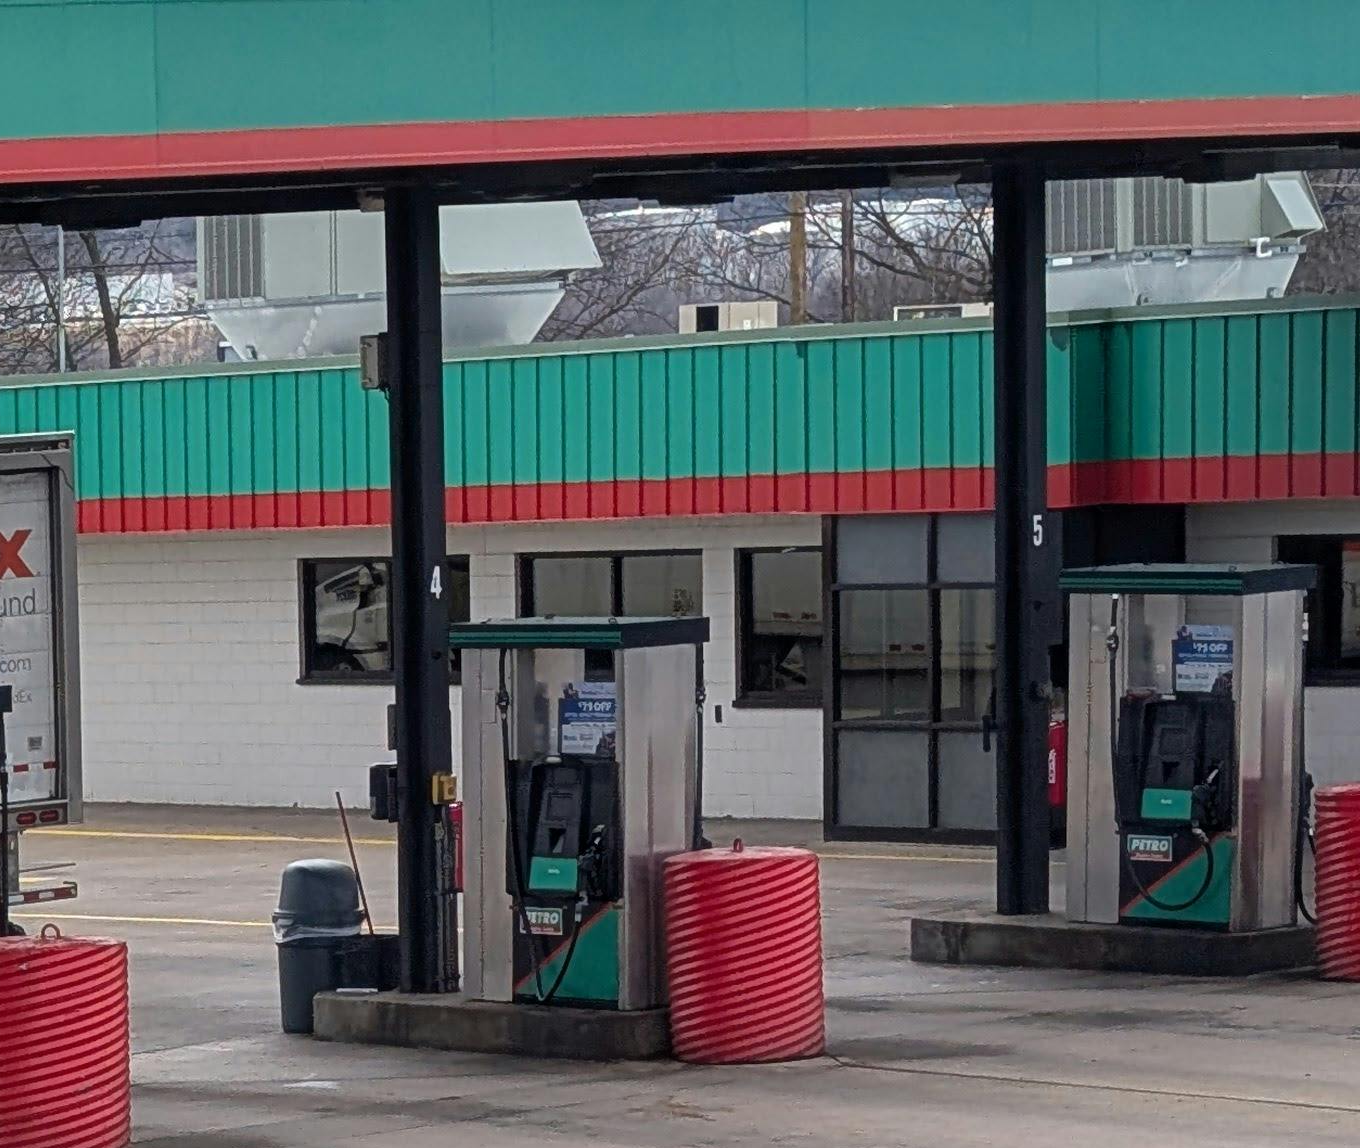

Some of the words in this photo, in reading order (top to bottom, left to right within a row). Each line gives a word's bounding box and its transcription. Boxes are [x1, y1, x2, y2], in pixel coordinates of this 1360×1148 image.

[1033, 514, 1042, 546] 5
[430, 565, 443, 600] 4
[1131, 839, 1169, 852] PETRO
